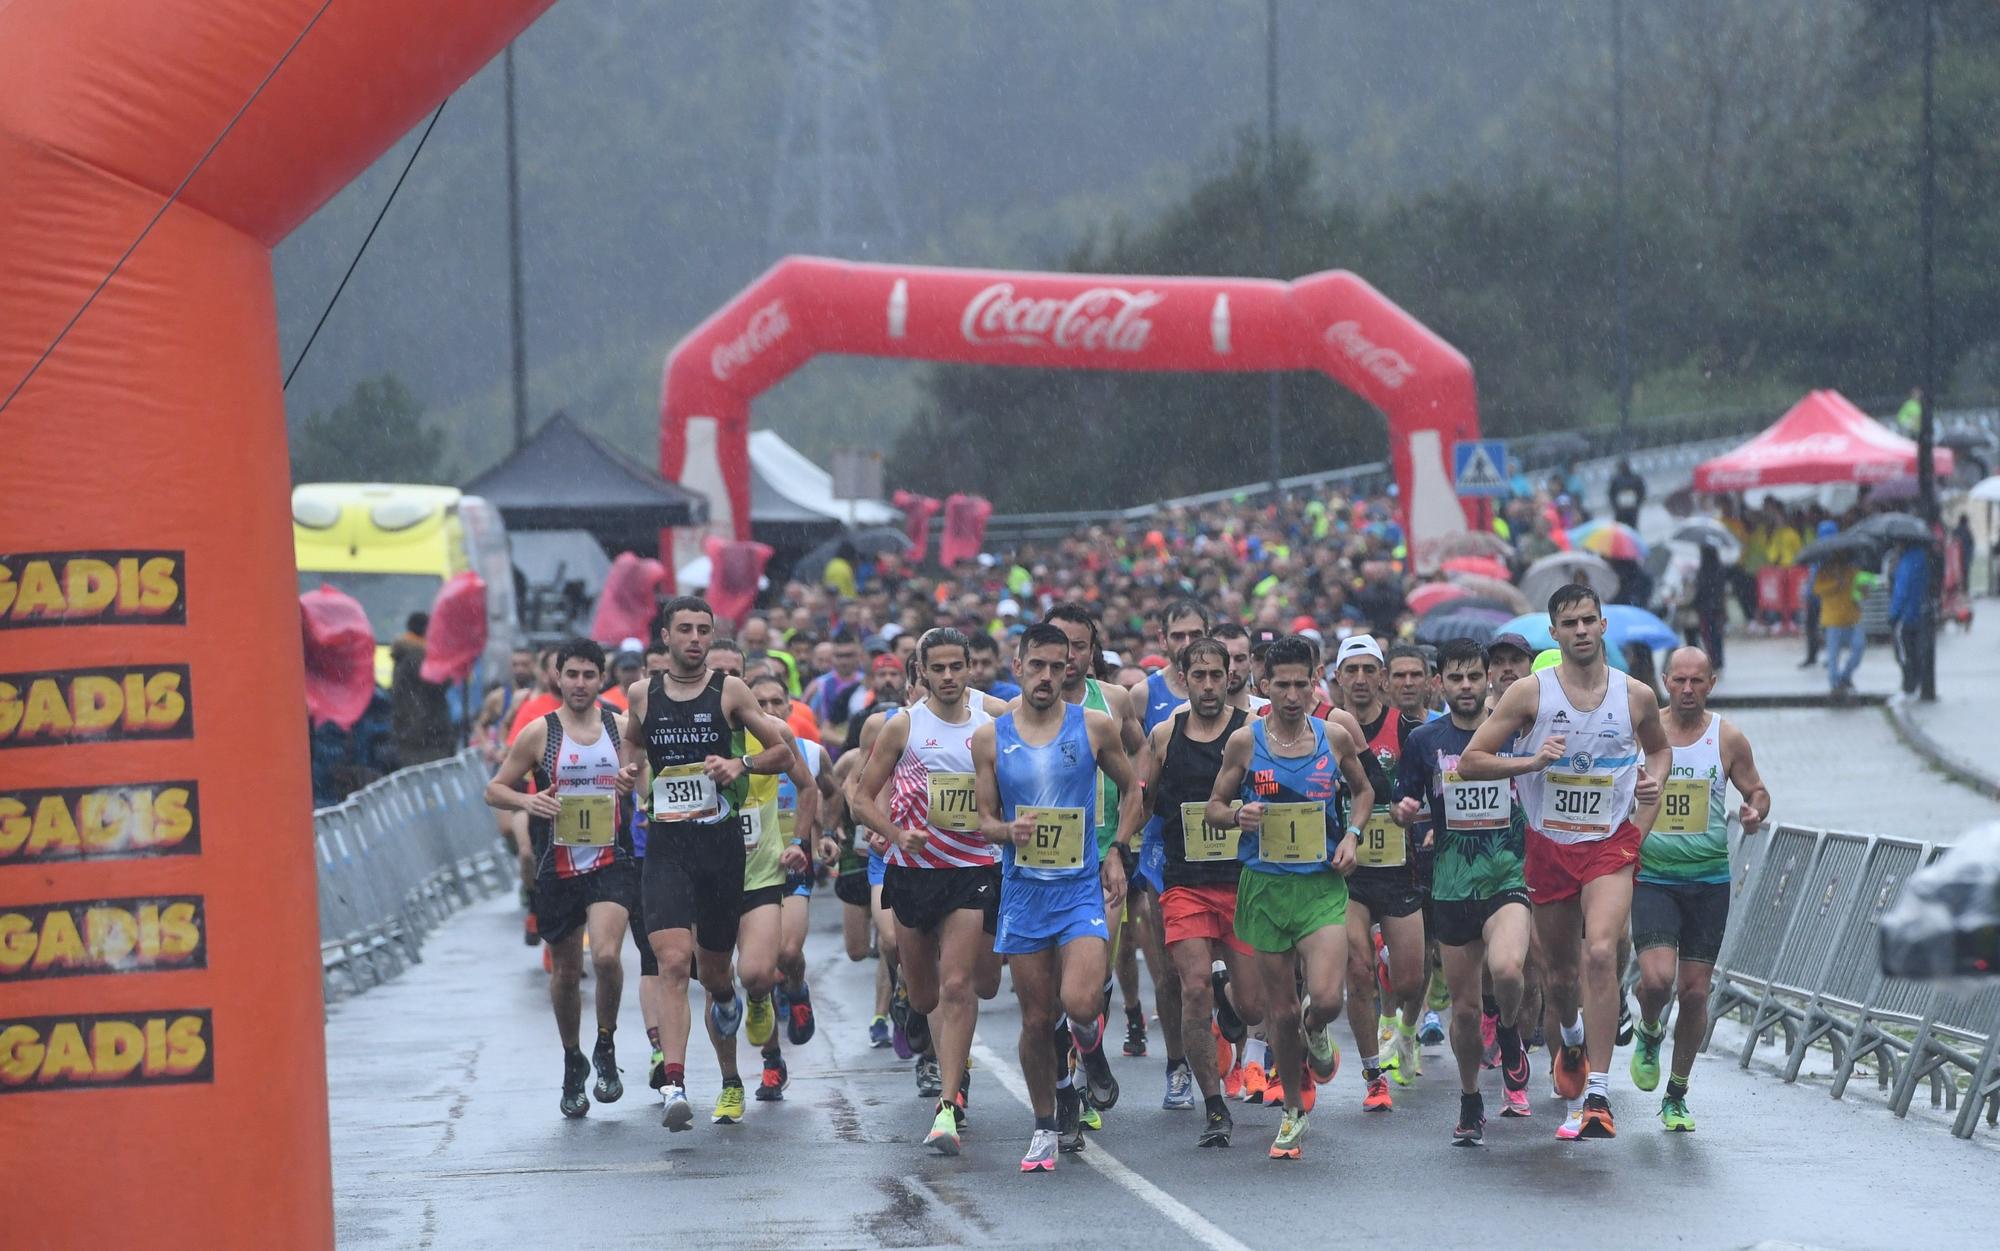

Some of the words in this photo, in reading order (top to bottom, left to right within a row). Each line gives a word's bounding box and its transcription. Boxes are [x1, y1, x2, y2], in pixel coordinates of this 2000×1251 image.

[650, 732, 719, 745] VIMIANZO
[655, 727, 697, 735] CONCELLO
[1254, 769, 1275, 783] AZIZ
[665, 779, 703, 803] 3311
[939, 788, 978, 813] 1770
[1455, 786, 1500, 810] 3312
[1555, 789, 1602, 815] 3012
[1665, 793, 1690, 816] 98
[0, 788, 193, 855] GADIS
[579, 808, 590, 830] 11
[1036, 824, 1063, 849] 67
[1289, 820, 1296, 844] 1
[1369, 828, 1385, 850] 19
[0, 902, 200, 975] GADIS
[0, 1016, 207, 1086] GADIS
